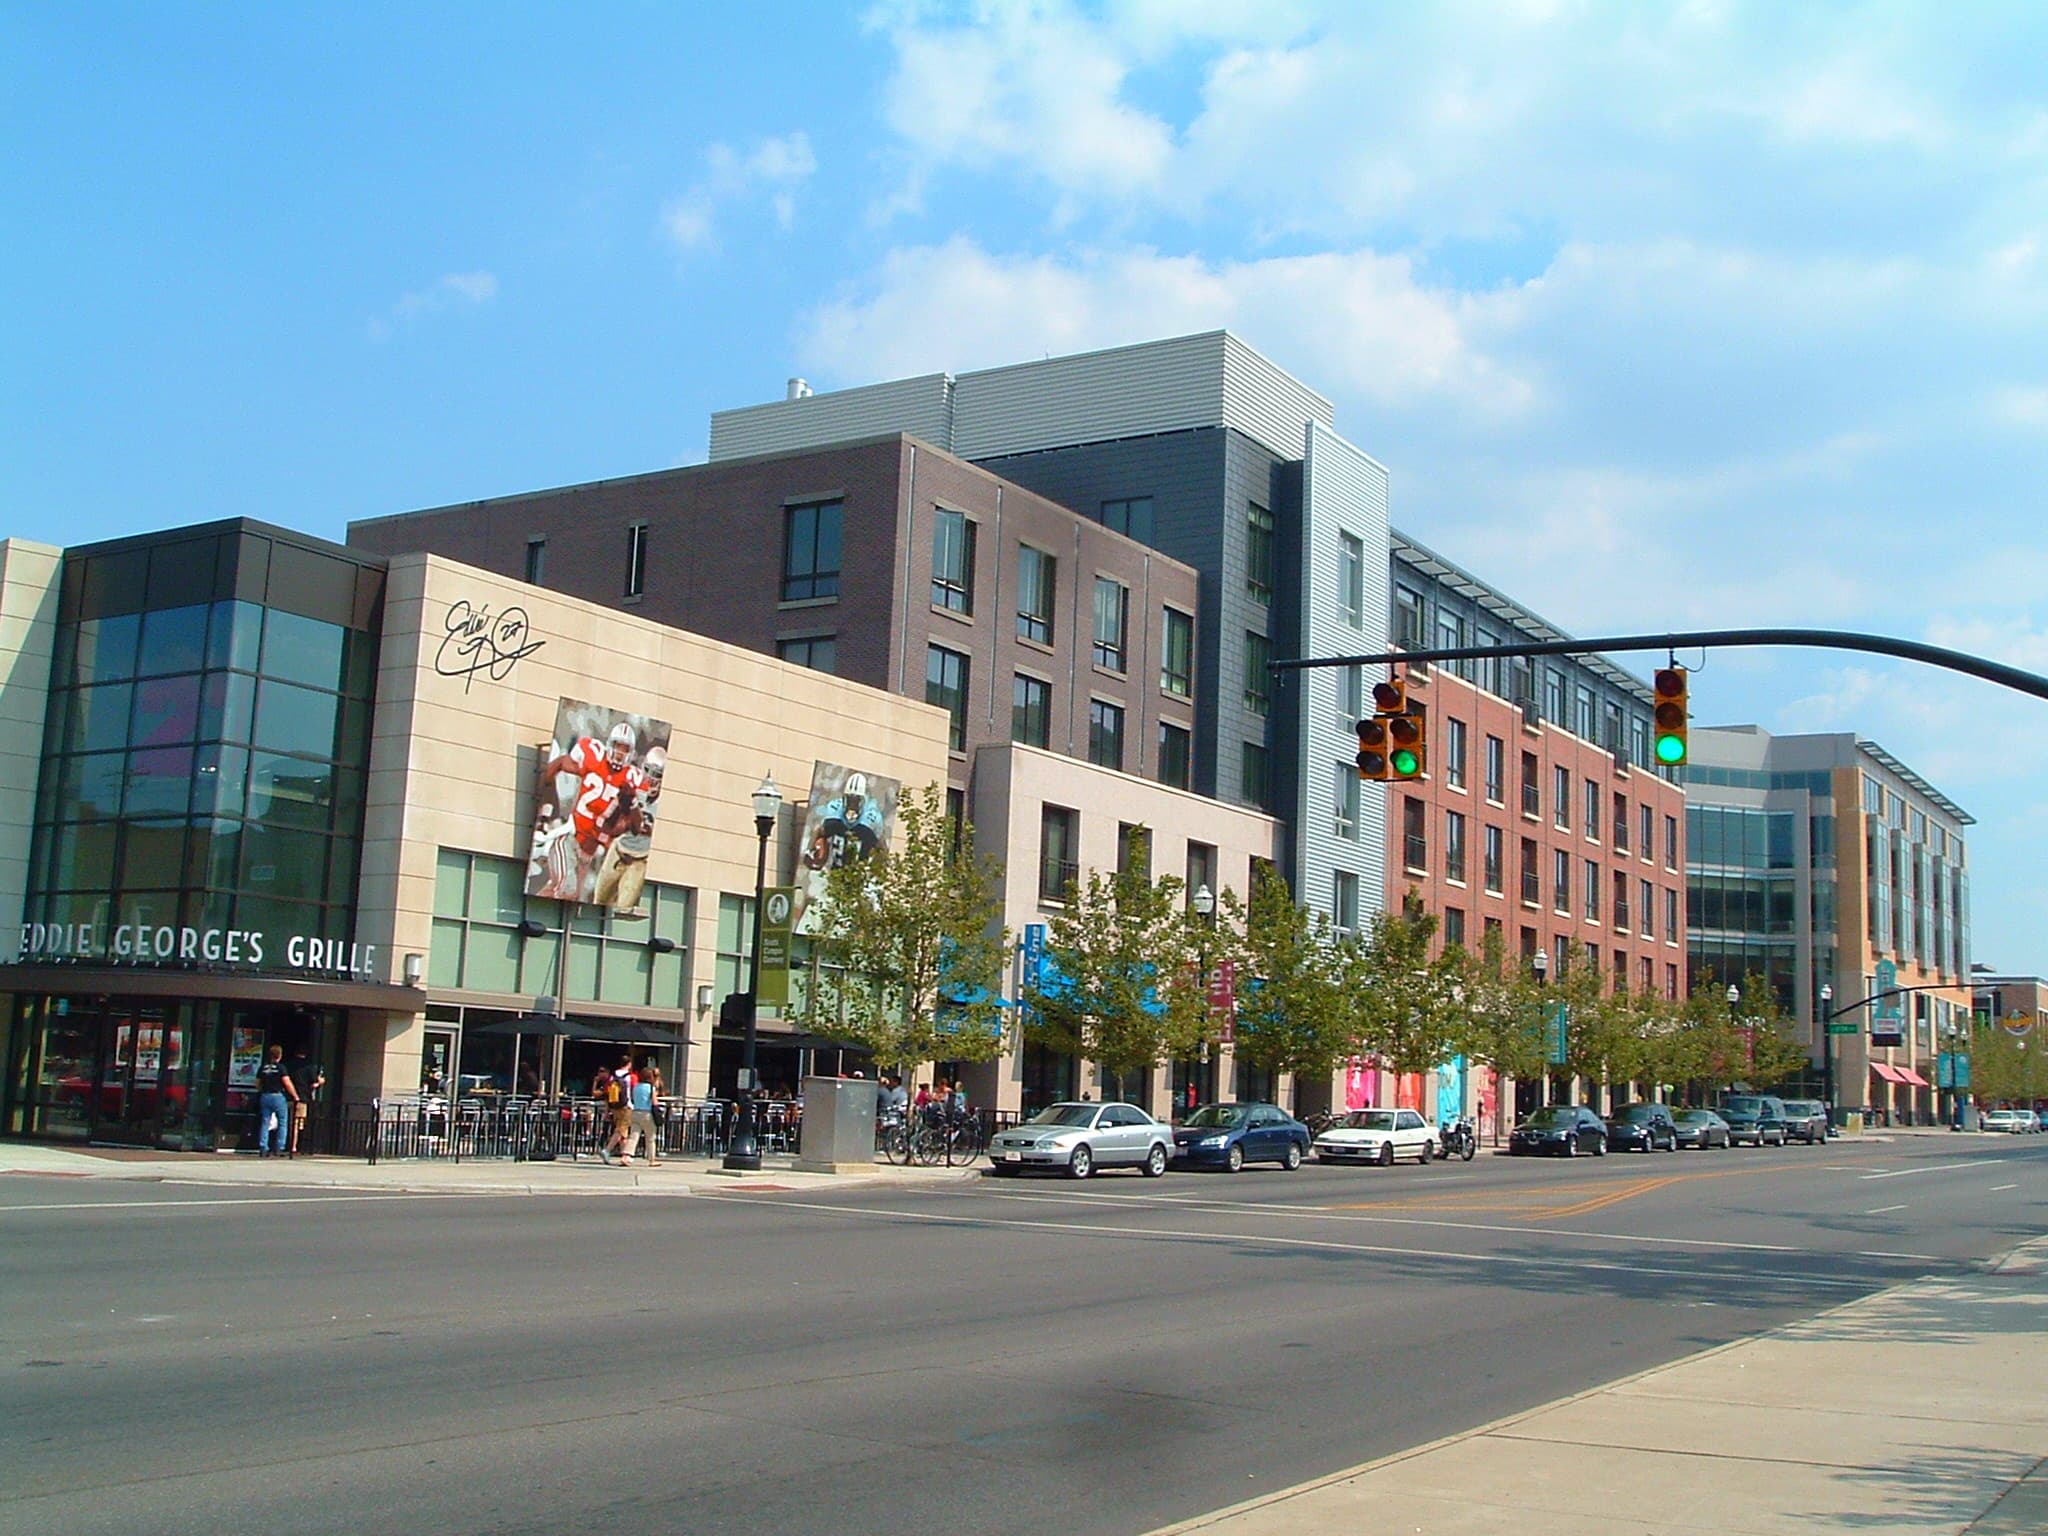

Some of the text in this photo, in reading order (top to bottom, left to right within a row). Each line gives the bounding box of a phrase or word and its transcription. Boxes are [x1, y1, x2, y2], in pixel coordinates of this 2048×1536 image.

[20, 922, 375, 975] EDDIE GEORGE'S GRILLE
